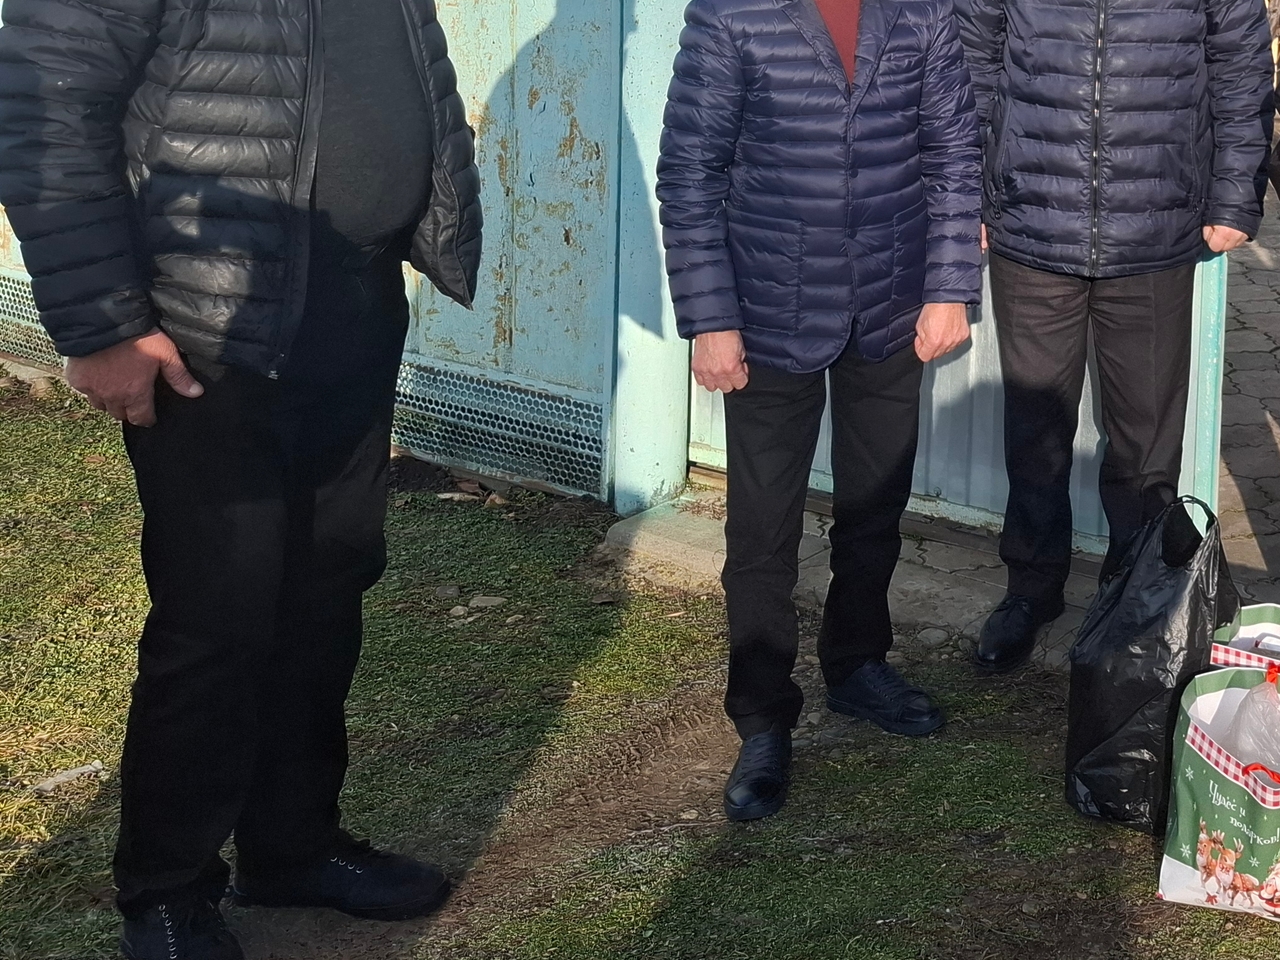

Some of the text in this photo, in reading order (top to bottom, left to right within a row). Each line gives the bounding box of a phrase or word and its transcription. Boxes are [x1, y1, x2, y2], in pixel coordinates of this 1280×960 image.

[1209, 779, 1246, 817] Чудес и
[1229, 816, 1280, 845] подарков!
